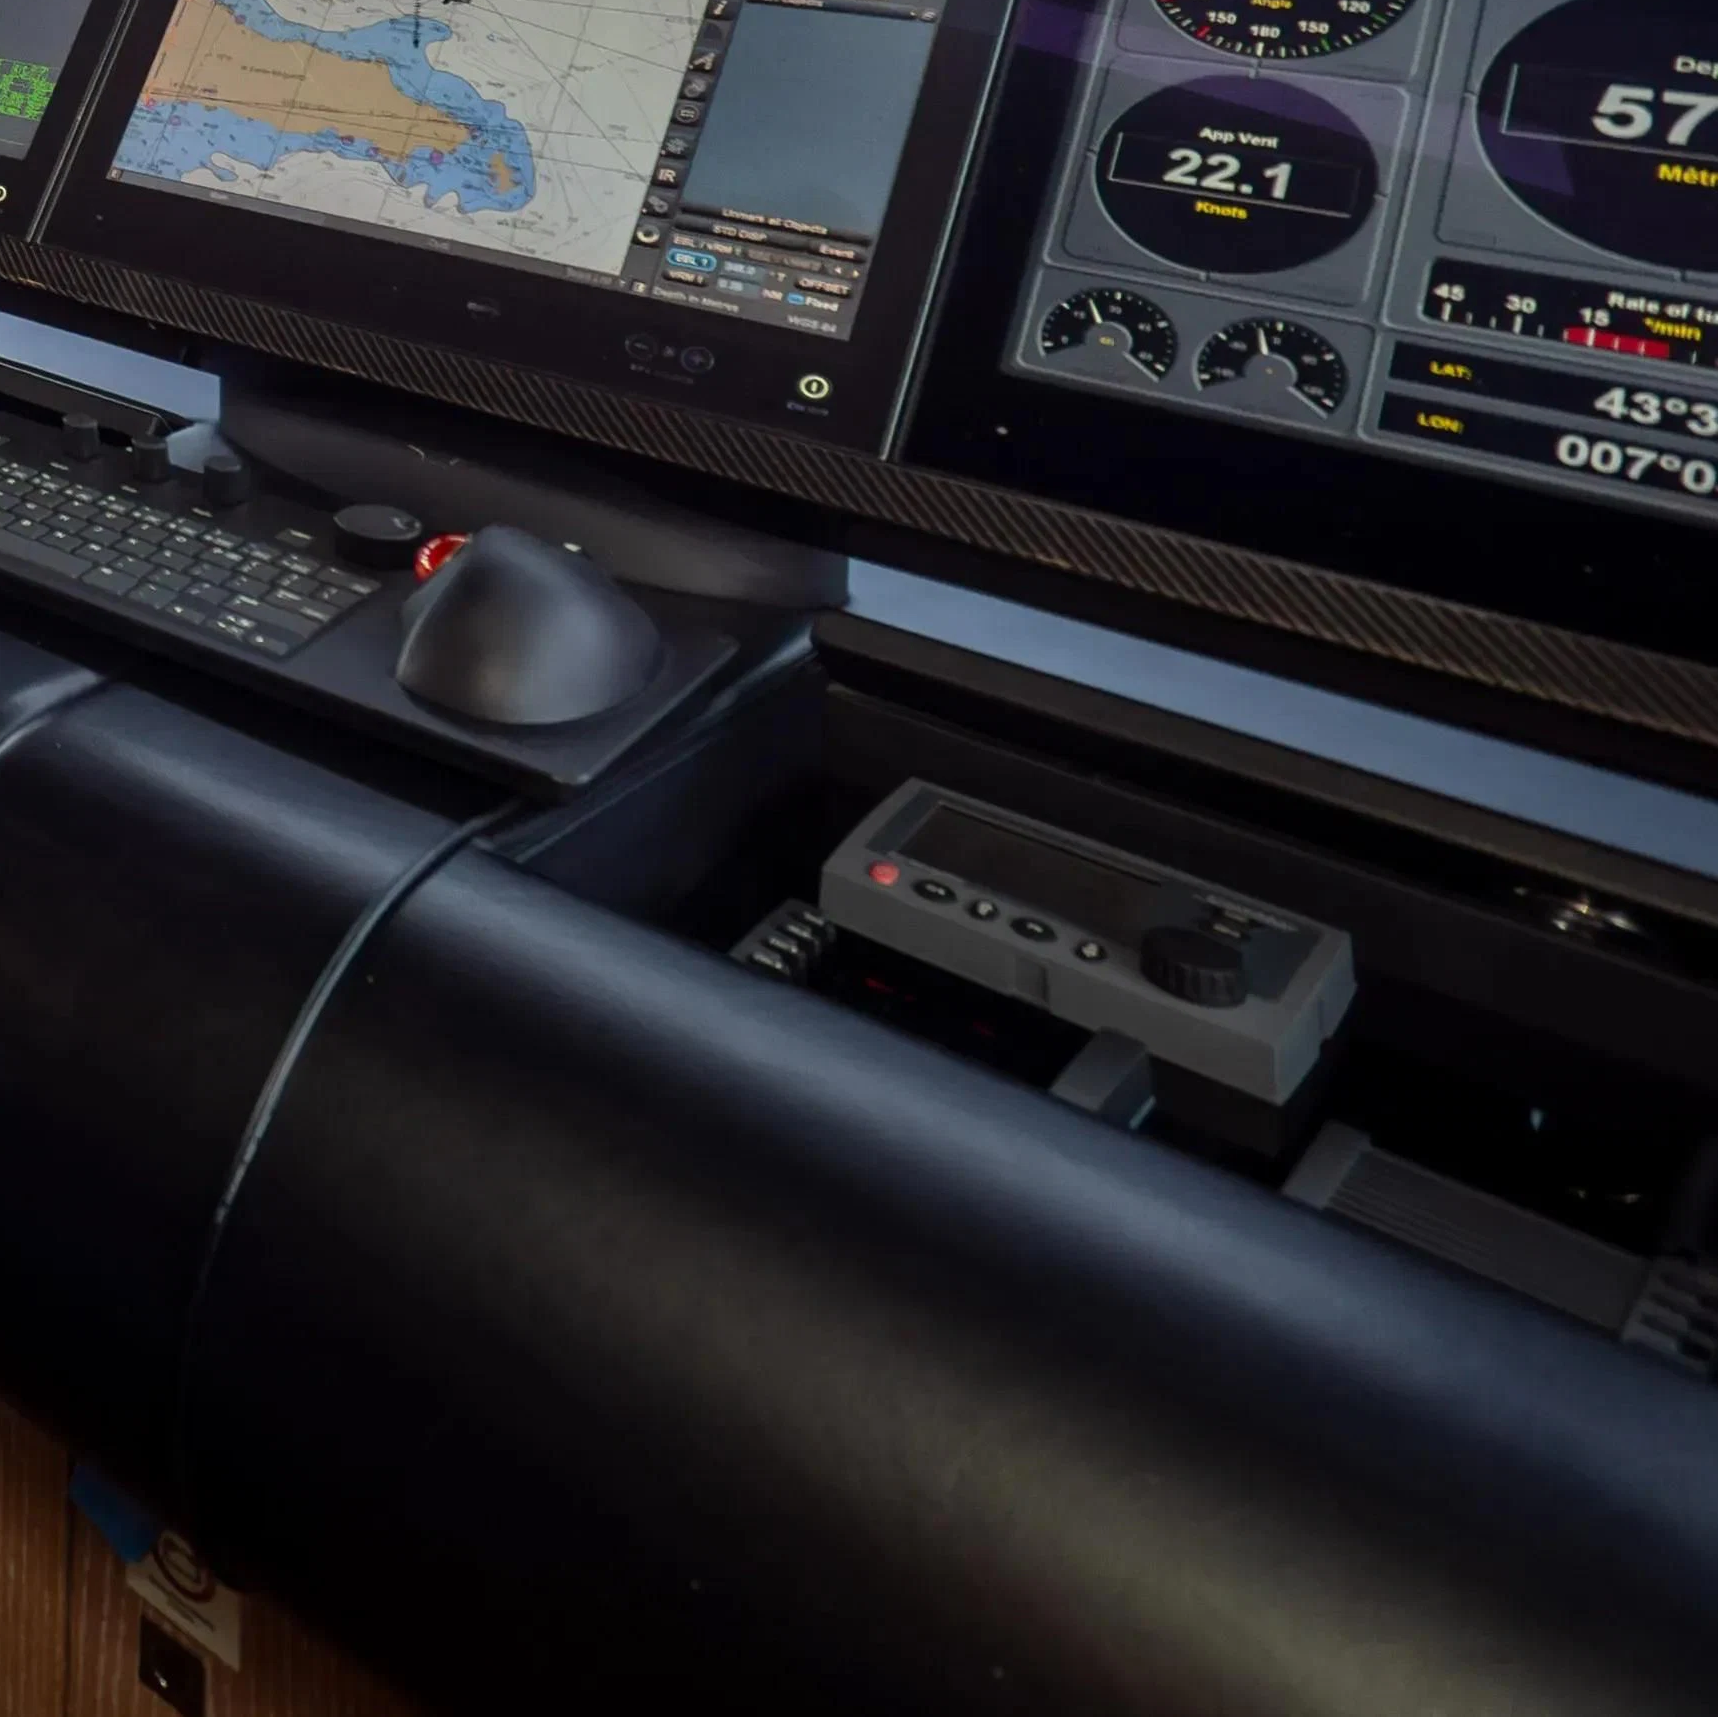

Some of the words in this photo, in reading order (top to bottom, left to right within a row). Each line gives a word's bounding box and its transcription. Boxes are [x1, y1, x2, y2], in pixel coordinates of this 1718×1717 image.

[1337, 0, 1371, 14] 120
[1206, 10, 1238, 25] 150
[1297, 20, 1330, 35] 150
[1249, 24, 1281, 39] 180
[1198, 126, 1235, 144] App
[1237, 131, 1281, 149] Vent
[1162, 147, 1293, 200] 22.1
[1193, 199, 1248, 220] Knots
[1433, 283, 1465, 302] 45
[1505, 294, 1538, 314] 30
[1607, 291, 1660, 314] Rate
[1663, 302, 1693, 320] of
[1578, 306, 1611, 327] 15
[1555, 434, 1718, 495] 007°0
